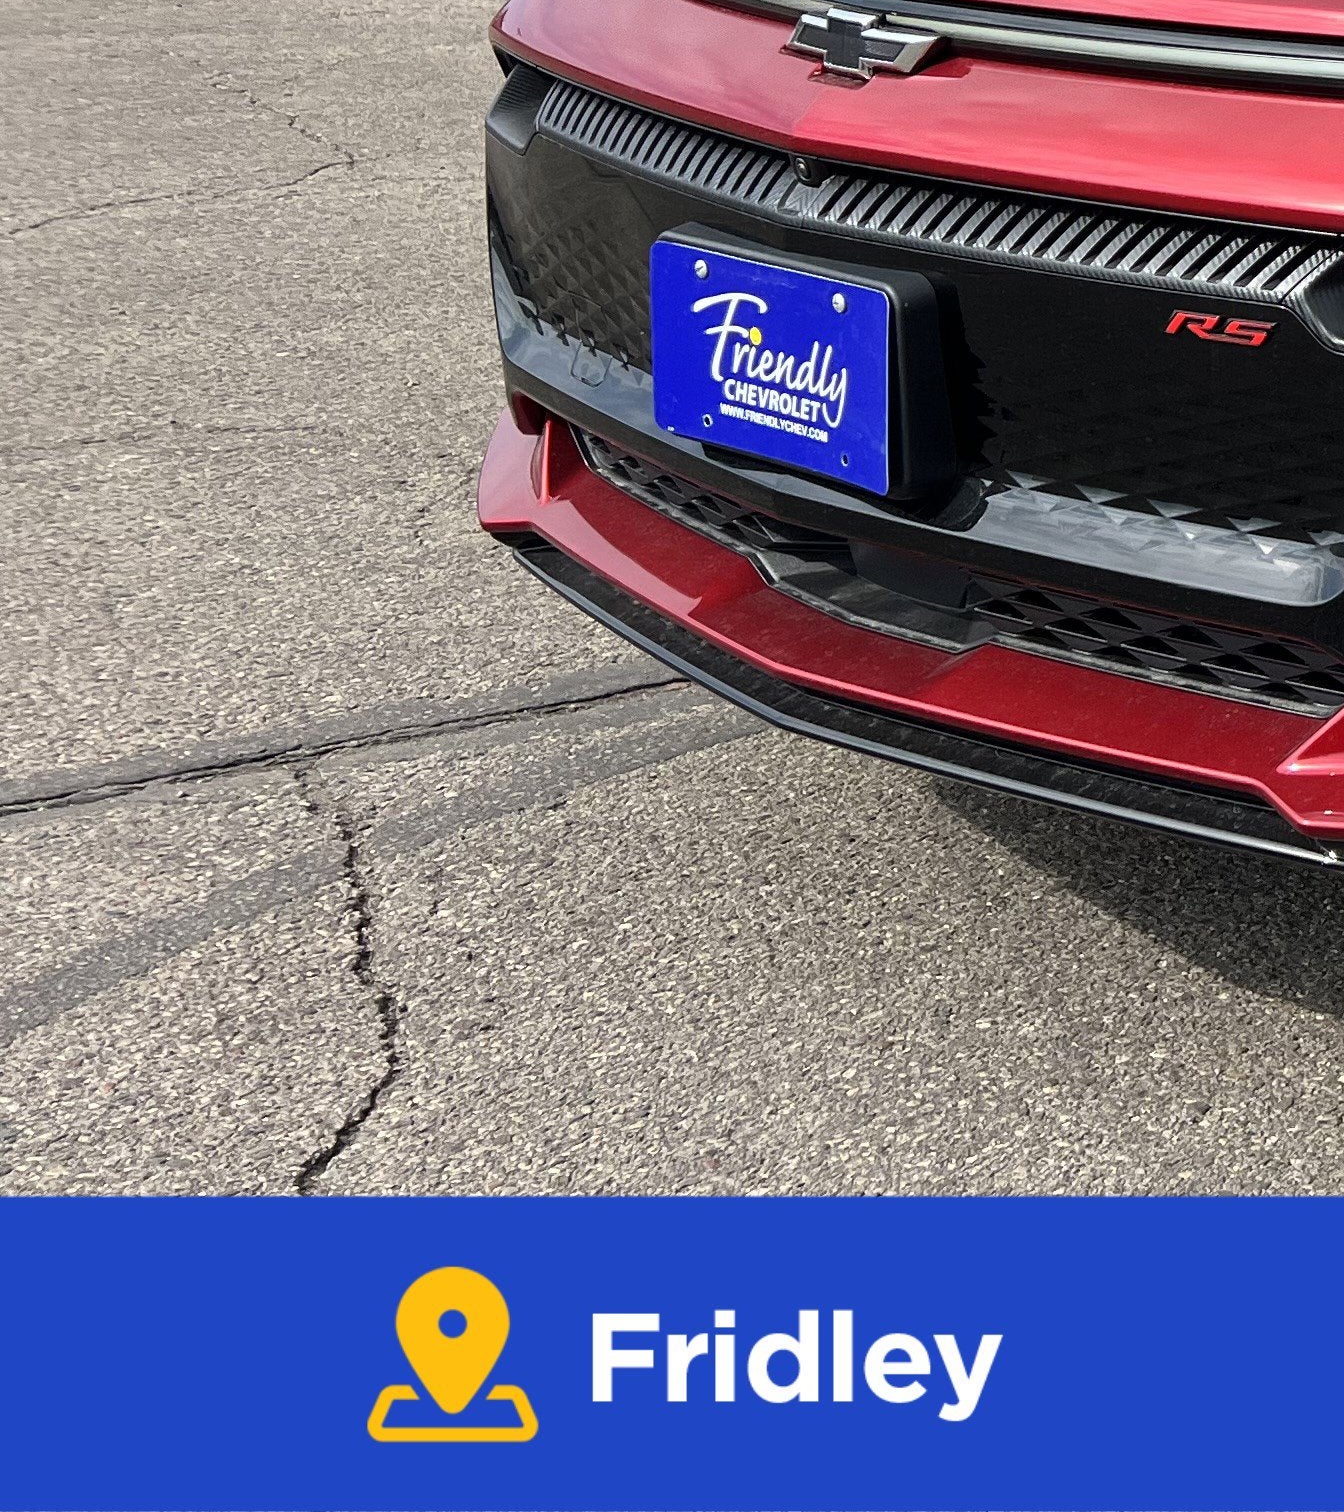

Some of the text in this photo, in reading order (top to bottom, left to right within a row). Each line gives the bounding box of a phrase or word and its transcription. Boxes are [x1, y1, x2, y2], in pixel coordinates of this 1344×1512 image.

[1164, 309, 1278, 347] RS
[692, 292, 847, 428] Friendly
[724, 378, 821, 422] CHEVROLET
[719, 402, 829, 443] WWW.FRIENDLYCHEV.COM
